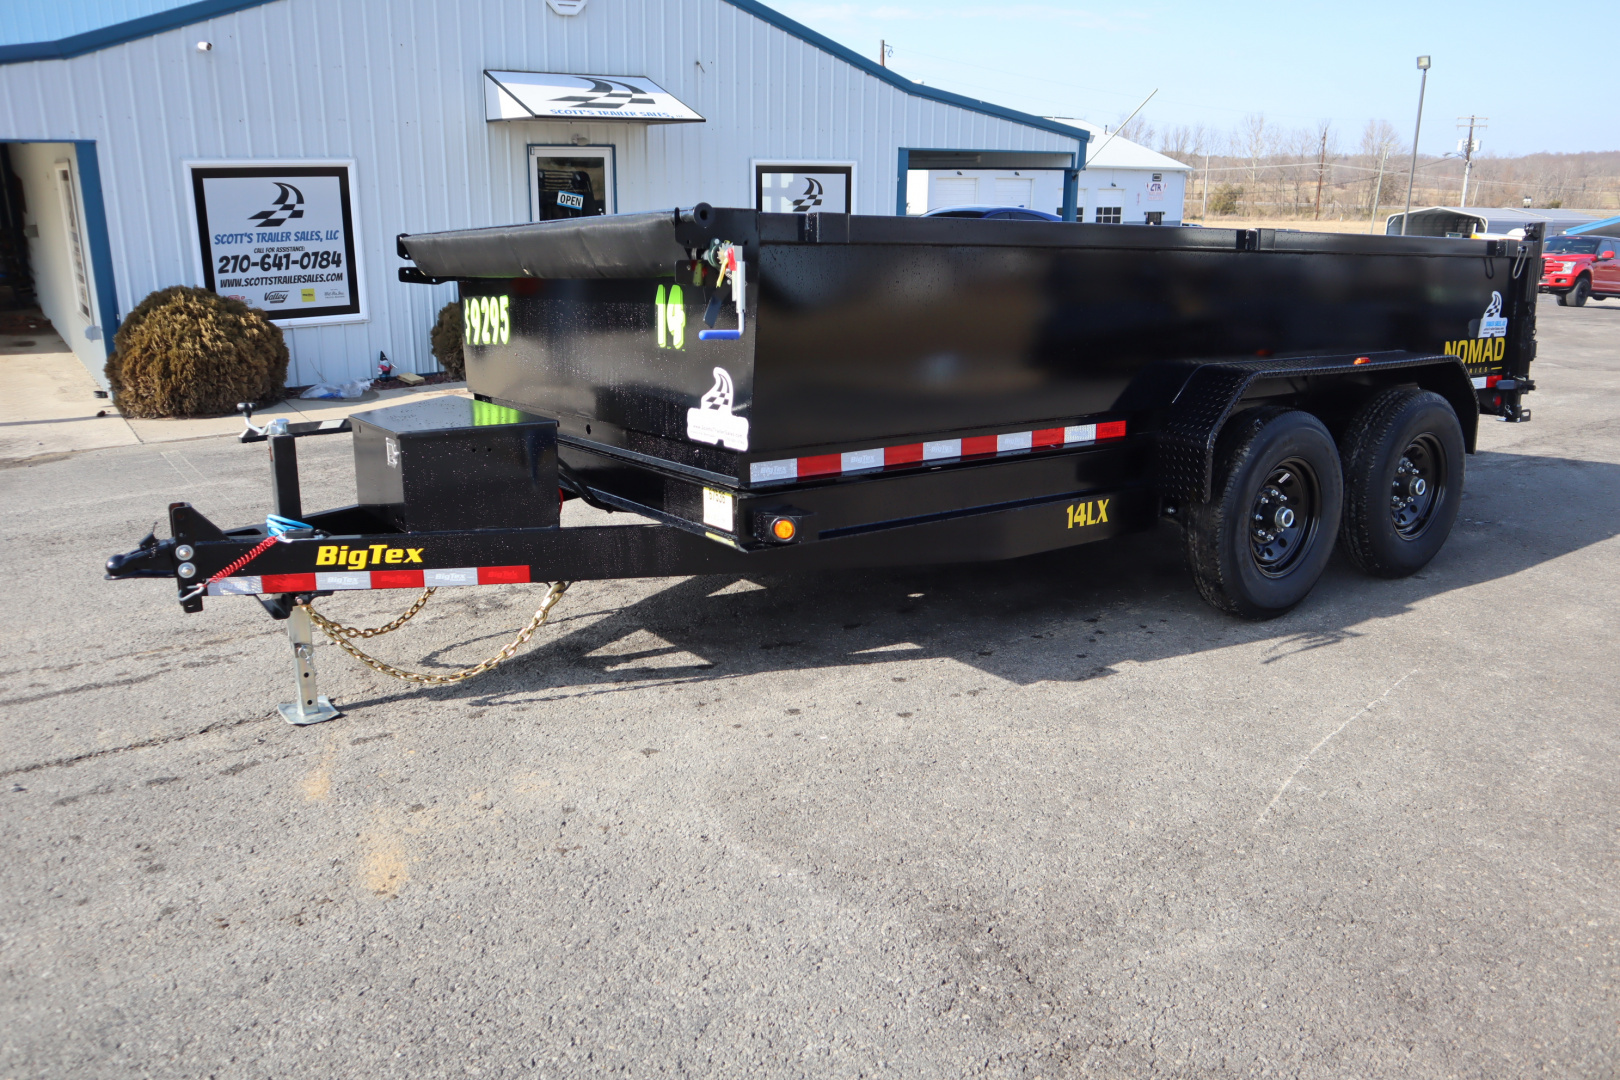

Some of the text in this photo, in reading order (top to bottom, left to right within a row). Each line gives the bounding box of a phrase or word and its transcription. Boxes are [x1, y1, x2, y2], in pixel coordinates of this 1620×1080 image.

[560, 194, 582, 207] OPEN
[214, 230, 340, 246] SCOTT'S TRAILER SALES, LLC
[218, 251, 342, 274] 270-641-0784
[220, 273, 343, 288] WWW.SCOTTSTRAILERSALES.COM
[264, 290, 290, 303] Valley
[464, 294, 511, 346] $9295
[1443, 337, 1506, 364] NOMAD
[1066, 498, 1110, 529] 14LX
[316, 544, 425, 570] BigTex
